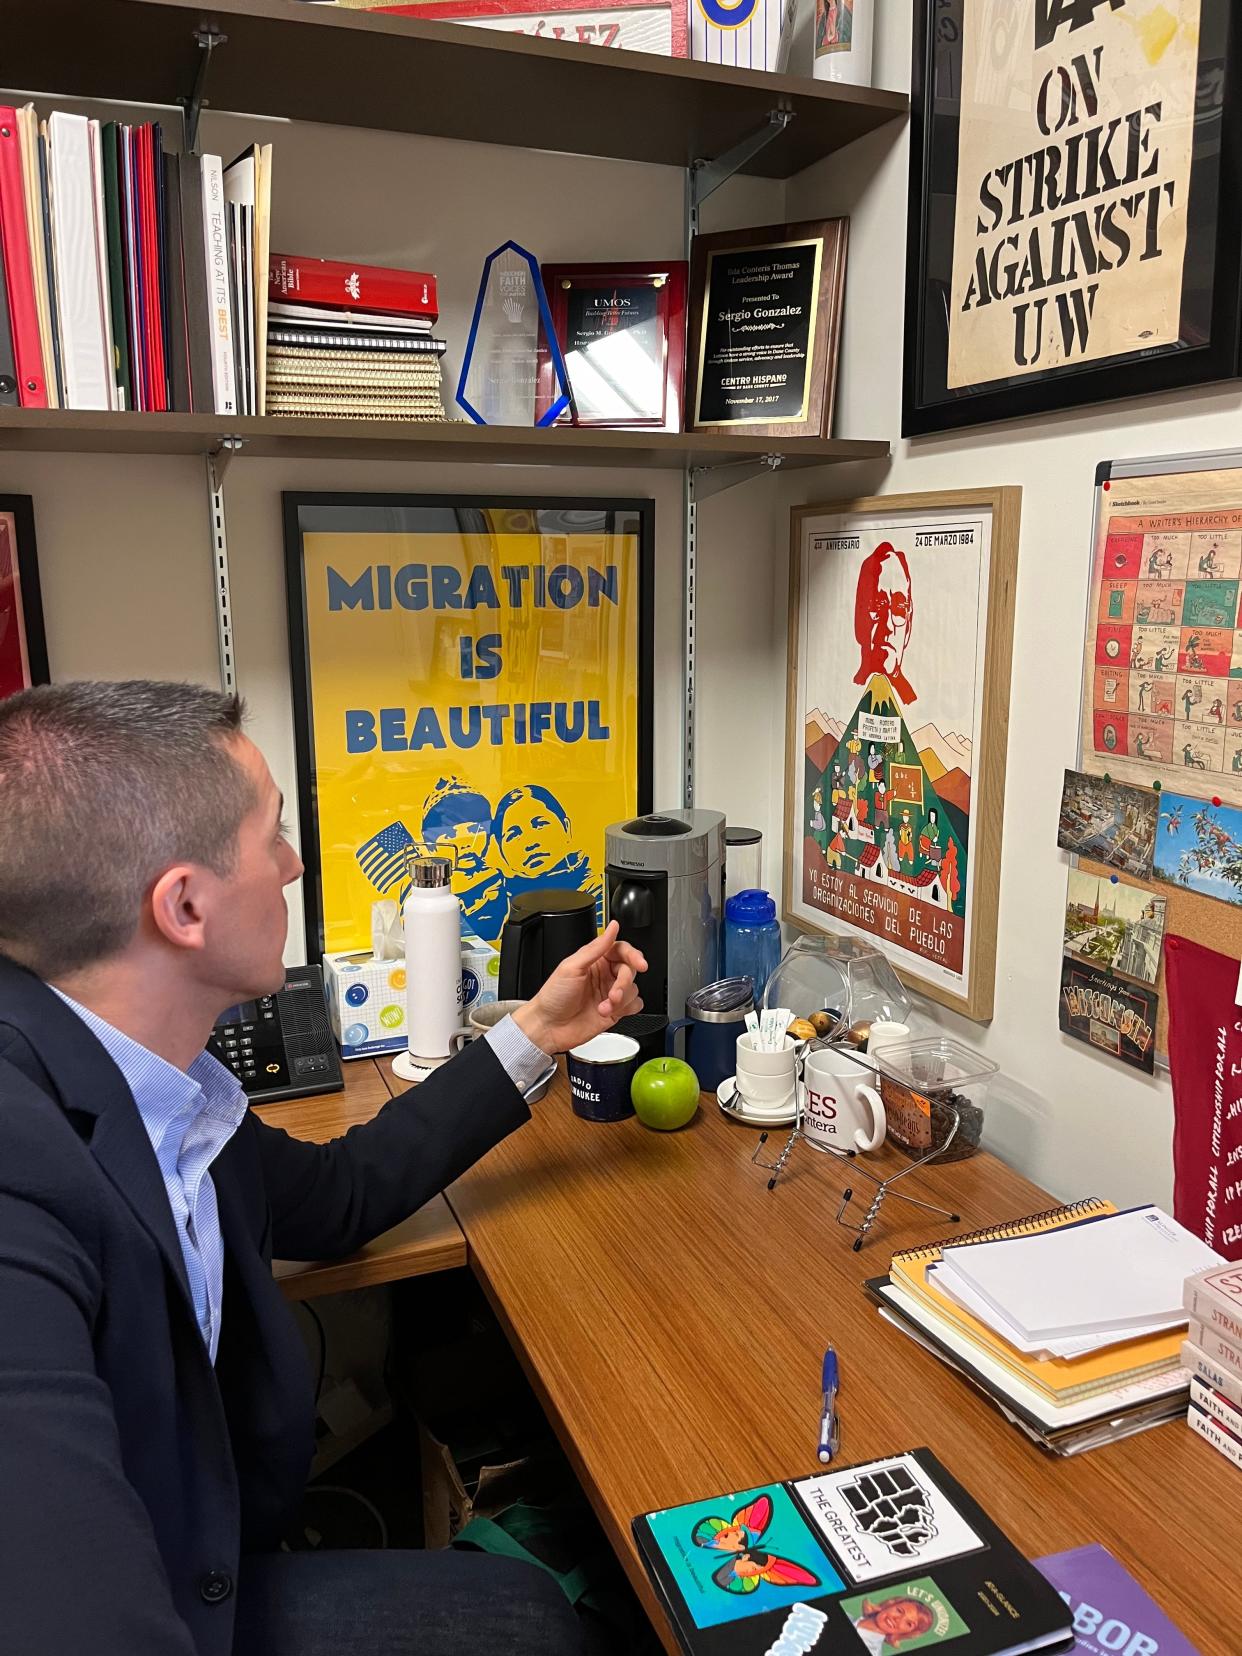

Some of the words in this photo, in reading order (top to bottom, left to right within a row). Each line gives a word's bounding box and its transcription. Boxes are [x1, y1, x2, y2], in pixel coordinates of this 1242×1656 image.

[1036, 46, 1105, 136] ON
[977, 101, 1163, 237] STRIKE
[210, 169, 220, 201] NILSON
[211, 211, 224, 266] TEACHING
[961, 180, 1174, 312] AGAINST
[216, 269, 226, 286] AT
[732, 273, 769, 284] Leadership
[770, 271, 794, 280] Award
[772, 262, 800, 271] Thomas
[500, 276, 526, 286] FAITH
[500, 285, 526, 293] VOICES
[216, 287, 227, 304] ITS
[594, 298, 631, 307] UMOS
[742, 294, 771, 303] Presented
[218, 308, 229, 341] BEST
[718, 309, 751, 322] Sergio
[753, 305, 802, 318] Gonzalez
[721, 376, 751, 386] CENTRO
[753, 374, 787, 384] HISPANO
[726, 396, 754, 405] November
[764, 395, 779, 403] 2017
[1137, 520, 1144, 528] A
[1150, 517, 1182, 528] WRITER'S
[1185, 515, 1228, 526] HIERARCHY
[826, 540, 860, 551] ANIVERSARIO
[915, 536, 923, 547] 24
[924, 536, 933, 546] DE
[934, 535, 958, 546] MARZO
[958, 533, 974, 545] 1984
[326, 563, 619, 612] MIGRATION
[460, 633, 503, 680] IS
[1101, 669, 1123, 678] EDITING
[1194, 679, 1214, 687] LITTLE
[345, 700, 610, 754] BEAUTIFUL
[1196, 725, 1216, 734] LITTLE
[808, 868, 818, 883] YO
[821, 873, 844, 891] ESTOY
[849, 885, 858, 900] AL
[862, 888, 899, 916] SERVICIO
[909, 907, 922, 926] DE
[933, 917, 953, 939] LAS
[812, 885, 875, 925] ORGANIZACIONES
[885, 918, 902, 936] DEL
[910, 927, 945, 955] PUEBLO
[1088, 973, 1117, 992] Greetings
[1063, 985, 1153, 1052] WISCONSIN
[1217, 1026, 1227, 1053] ALL
[1215, 1053, 1225, 1080] FOR
[804, 1087, 837, 1119] ES
[1211, 1079, 1223, 1157] CITIZENSHIP
[1209, 1165, 1219, 1190] ALL
[1206, 1190, 1218, 1217] FOR
[1198, 1361, 1224, 1387] SALAS
[1198, 1391, 1224, 1417] FAITH
[1226, 1414, 1239, 1428] AND
[1196, 1419, 1221, 1444] FAITH
[1222, 1442, 1237, 1457] AND
[810, 1487, 832, 1510] THE
[824, 1509, 872, 1567] GREATEST
[907, 1585, 934, 1602] LET'S
